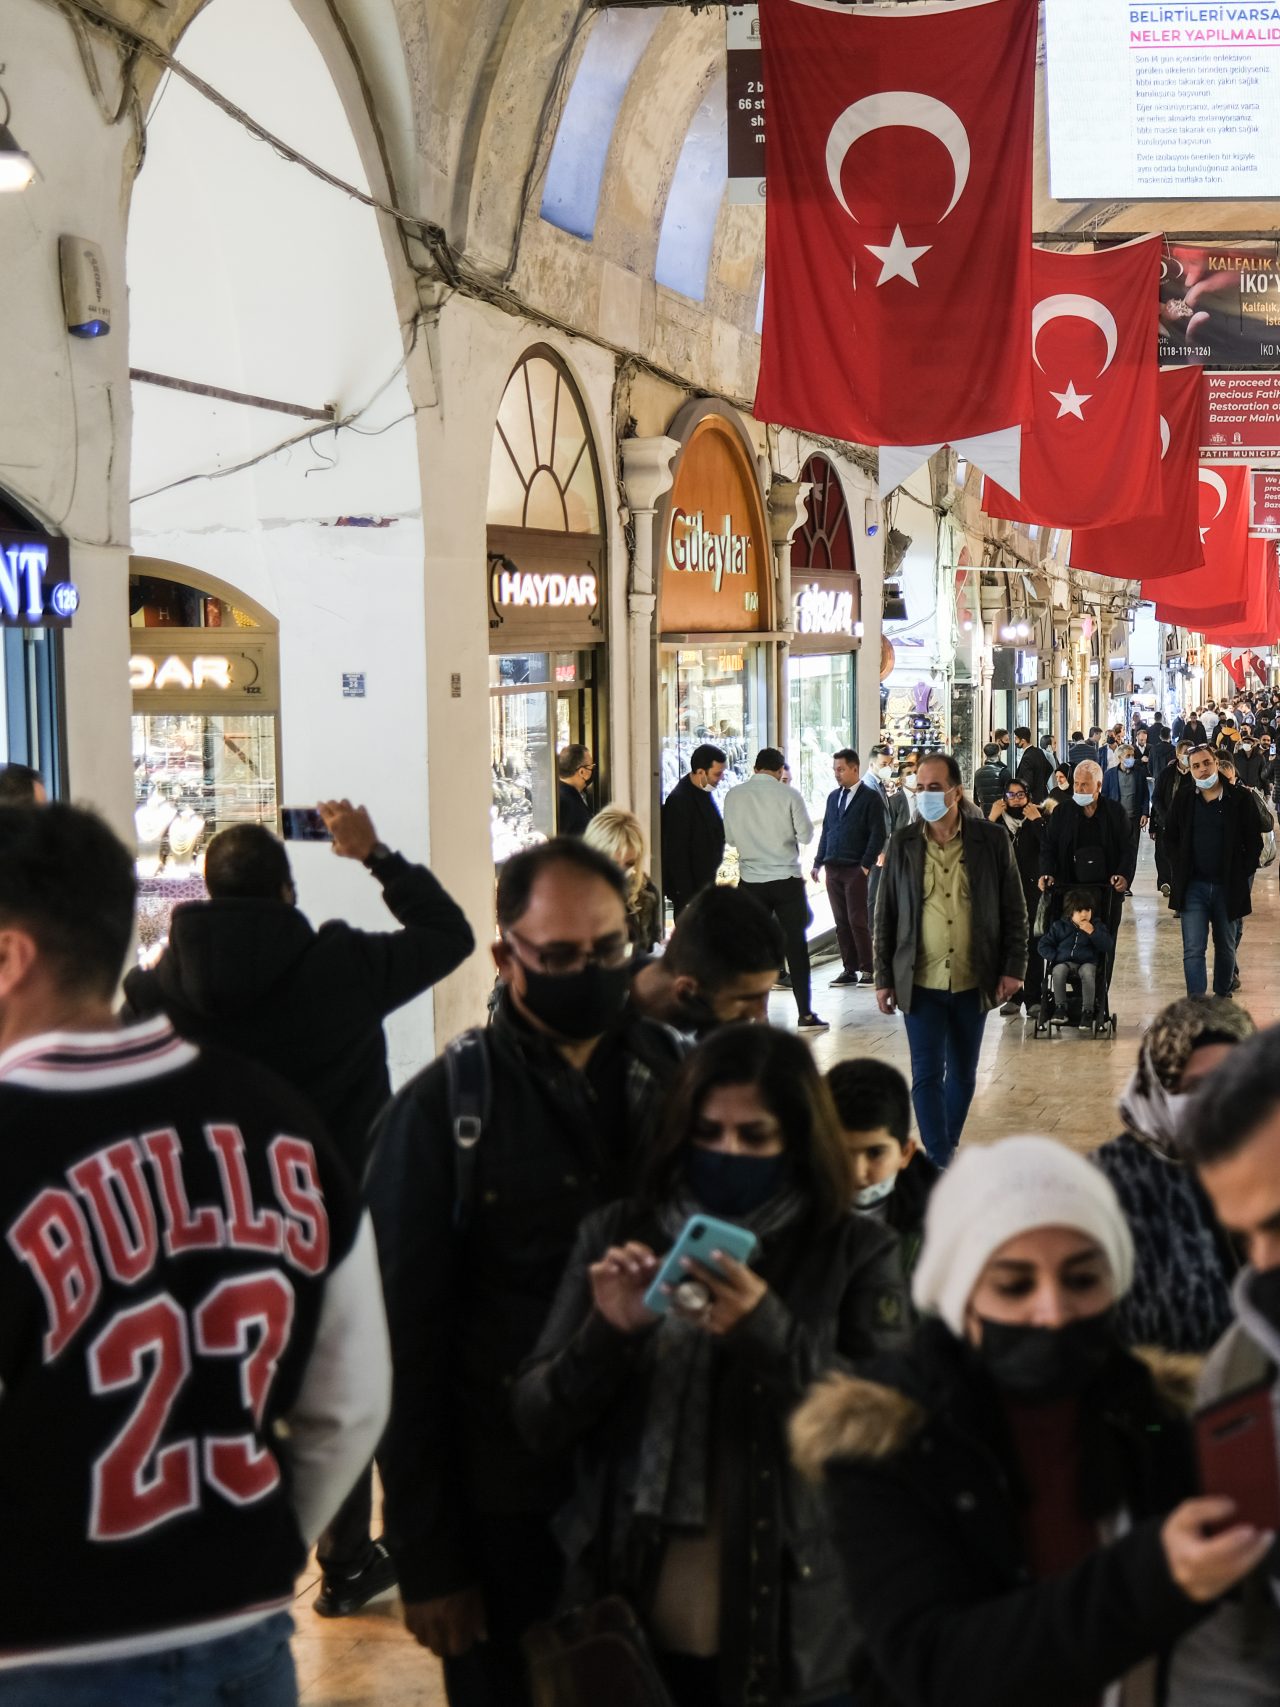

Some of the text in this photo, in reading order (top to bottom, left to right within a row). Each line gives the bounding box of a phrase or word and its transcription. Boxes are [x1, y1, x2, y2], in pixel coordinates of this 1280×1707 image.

[1129, 6, 1224, 22] BELİRTİLERİ
[1130, 30, 1181, 42] NELER
[747, 82, 754, 92] 2
[738, 98, 752, 110] 66
[1208, 256, 1272, 271] KALFALIK
[1242, 302, 1280, 314] Kalfalık,
[1160, 346, 1211, 356] (118-119-126)
[1260, 343, 1274, 356] İKO
[1209, 378, 1226, 387] We
[1228, 378, 1271, 389] proceed
[1208, 390, 1254, 400] precious
[1209, 402, 1270, 410] Restoration
[1209, 414, 1246, 422] Bazaar
[500, 572, 598, 607] HAYDAR
[6, 1123, 330, 1365] BULLS
[87, 1268, 297, 1542] 23
